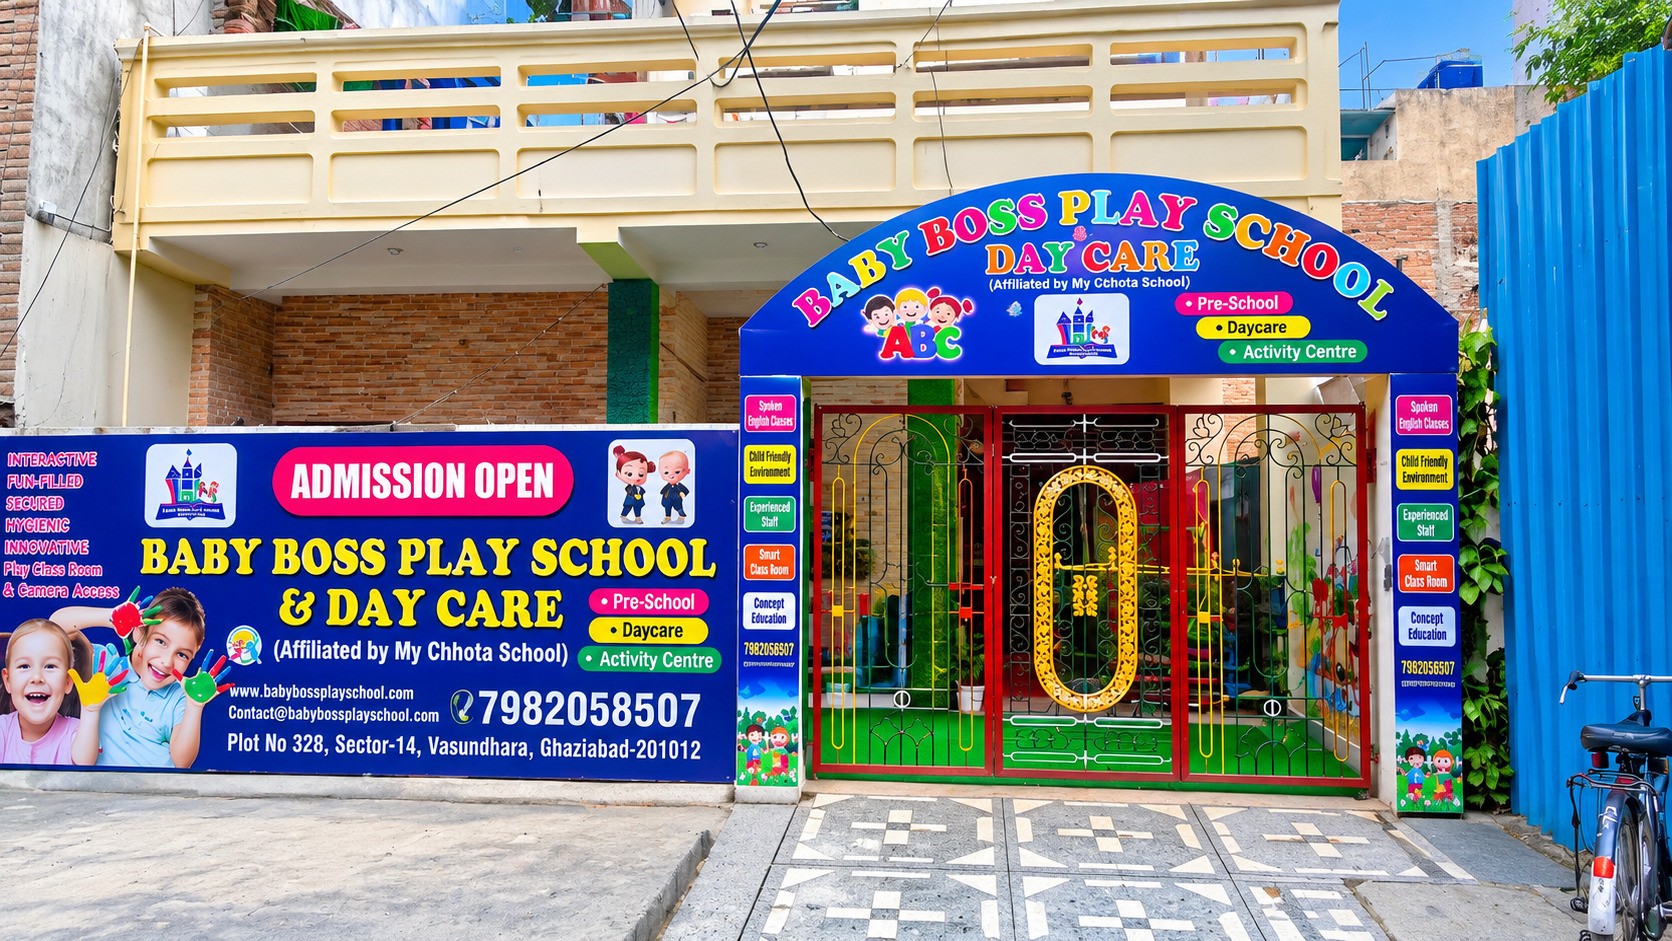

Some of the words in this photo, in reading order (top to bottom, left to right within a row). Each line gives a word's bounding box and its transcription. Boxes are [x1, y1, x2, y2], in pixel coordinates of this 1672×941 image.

[792, 230, 912, 328] BABY
[918, 193, 1048, 256] BOSS
[1058, 190, 1198, 231] PLAY
[1203, 203, 1394, 321] SCHOOL
[985, 241, 1073, 275] DAY
[1082, 240, 1200, 272] CARE
[1053, 277, 1068, 291] by
[1072, 276, 1091, 291] My
[1142, 275, 1191, 290] School)
[1197, 295, 1278, 311] Pre-School
[1228, 320, 1287, 336] Daycare
[879, 325, 962, 360] ABC
[1243, 344, 1300, 361] Activity
[1305, 345, 1357, 359] Centre
[1411, 400, 1438, 414] Spoken
[7, 451, 98, 468] INTERACTIVE
[7, 474, 84, 490] FUN-FILLED
[291, 462, 465, 499] ADMISSION
[475, 461, 554, 499] OPEN
[5, 496, 65, 512] SECURED
[5, 518, 70, 533] HYGIENIC
[4, 540, 90, 555] INNOVATIVE
[140, 537, 262, 576] BABY
[271, 537, 386, 576] BOSS
[398, 538, 520, 577] PLAY
[530, 537, 717, 578] SCHOOL
[32, 562, 65, 576] Class
[3, 582, 14, 598] &
[18, 582, 69, 598] Camera
[72, 582, 120, 598] Access
[279, 588, 315, 626] &
[326, 588, 426, 627] DAY
[436, 589, 564, 628] CARE
[613, 593, 695, 610] Pre-School
[754, 597, 785, 611] Concept
[751, 612, 787, 625] Education
[1411, 611, 1443, 626] Concept
[622, 621, 683, 641] Daycare
[1408, 627, 1447, 640] Education
[273, 639, 362, 663] (Affiliated
[367, 641, 389, 664] by
[395, 641, 422, 665] My
[427, 641, 493, 661] Chhota
[499, 642, 568, 667] School)
[600, 651, 657, 670] Activity
[662, 651, 714, 668] Centre
[229, 684, 414, 702] www.babybossplayschool.com
[228, 705, 440, 723] Contact@babybossplayschool.com
[478, 689, 701, 728] 7982058507
[227, 733, 260, 752] Plot
[265, 734, 287, 752] No
[292, 734, 329, 756] 328,
[335, 734, 422, 758] Sector-14,
[428, 736, 534, 761] Vasundhara,
[540, 737, 701, 760] Ghaziabad-201012
